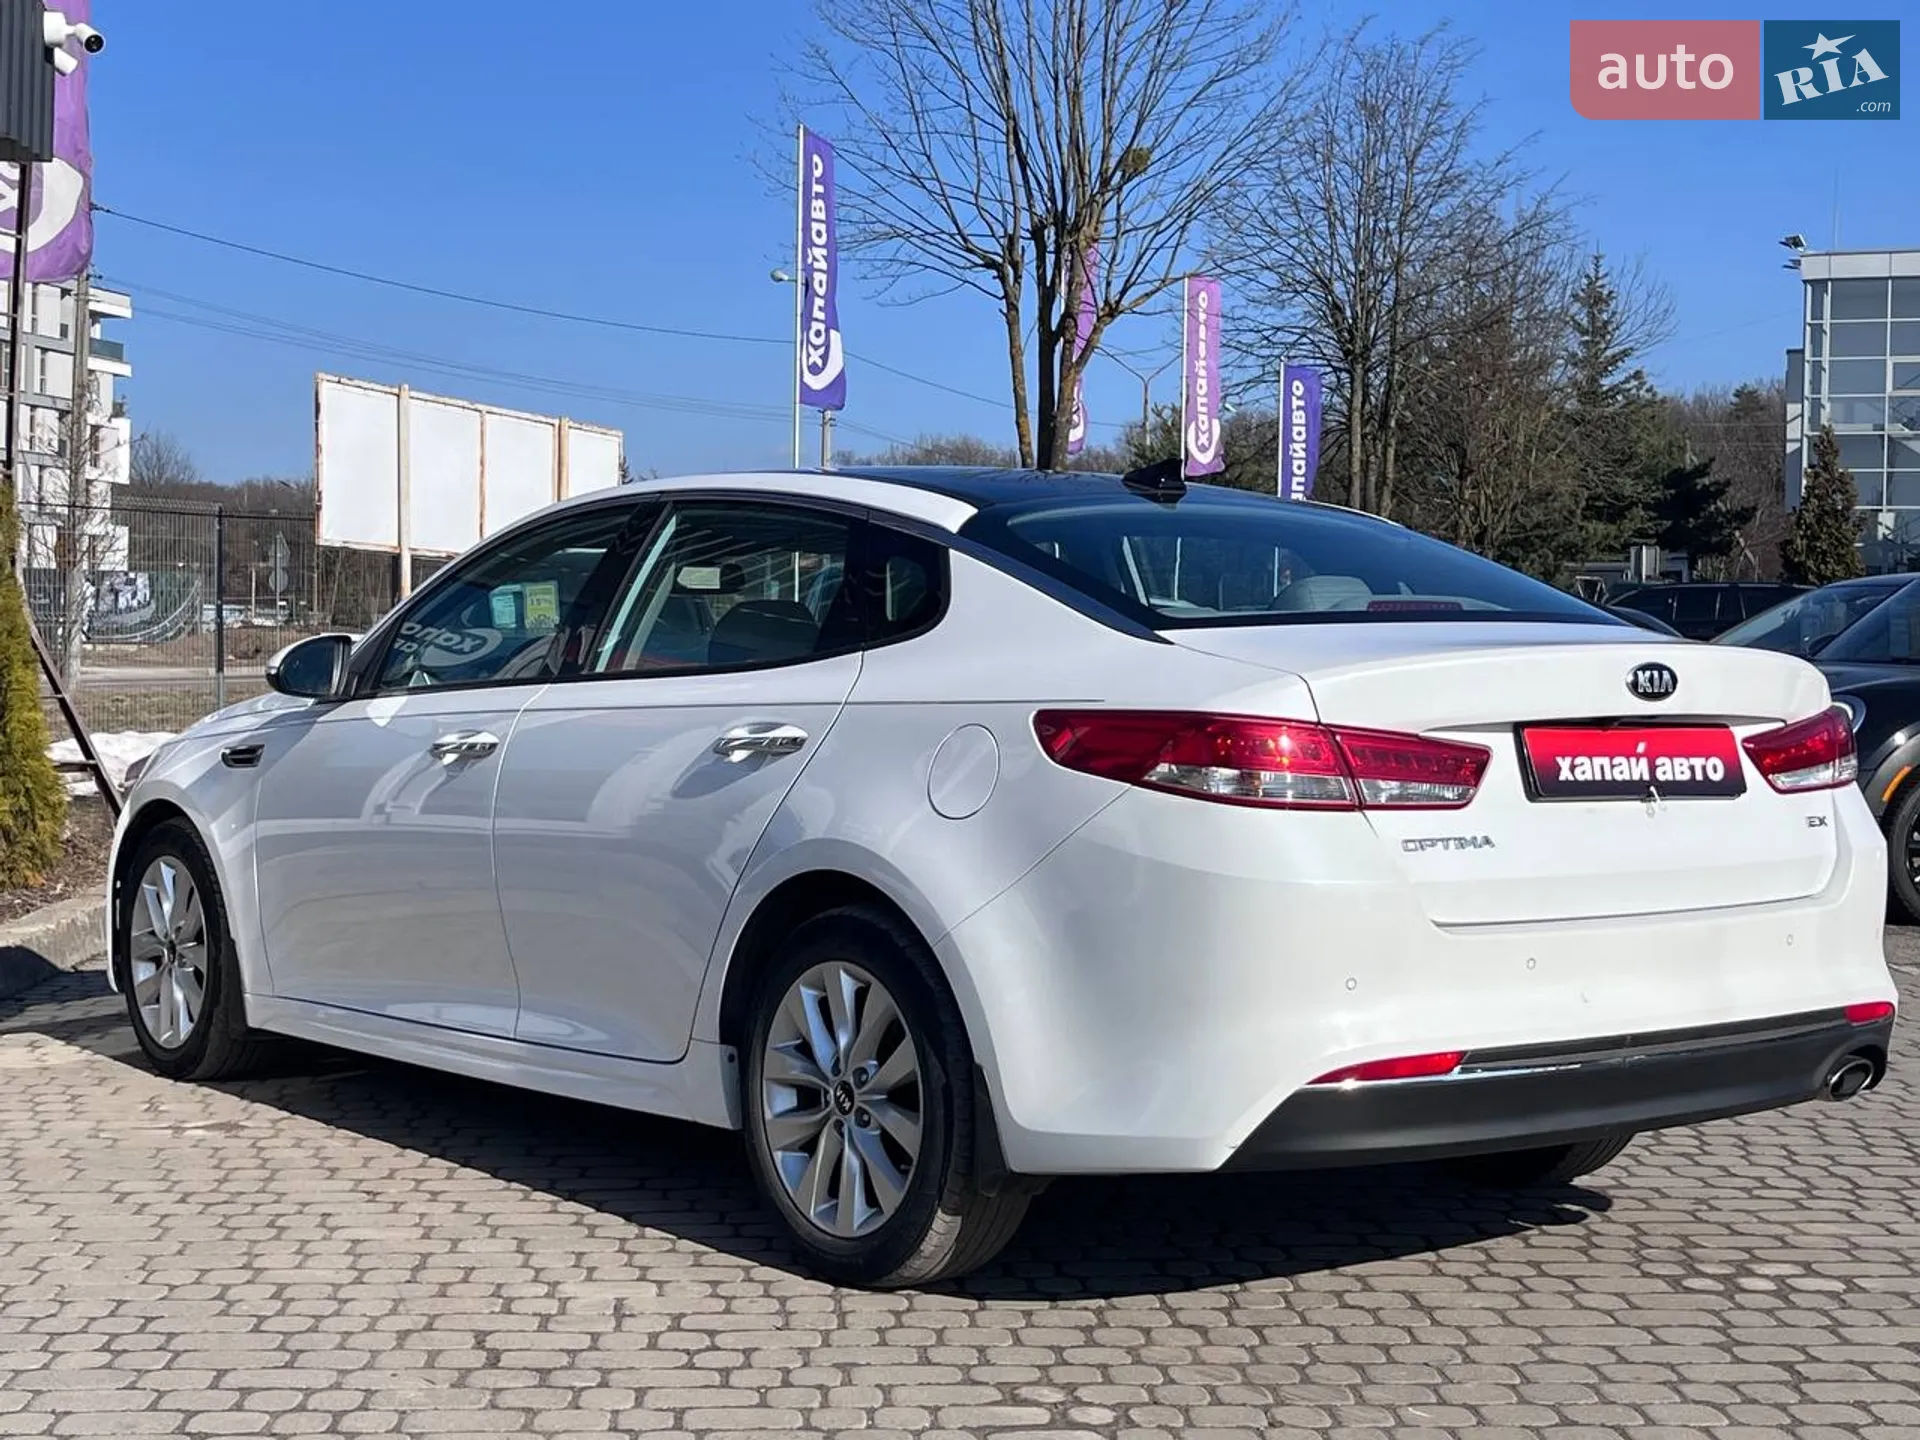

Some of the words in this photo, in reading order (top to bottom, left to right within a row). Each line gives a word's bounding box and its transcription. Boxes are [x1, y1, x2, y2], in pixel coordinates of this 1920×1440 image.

[1636, 669, 1673, 693] KIA
[1655, 756, 1725, 781] авто
[1806, 815, 1828, 828] EX
[1401, 835, 1495, 852] OPTIMA
